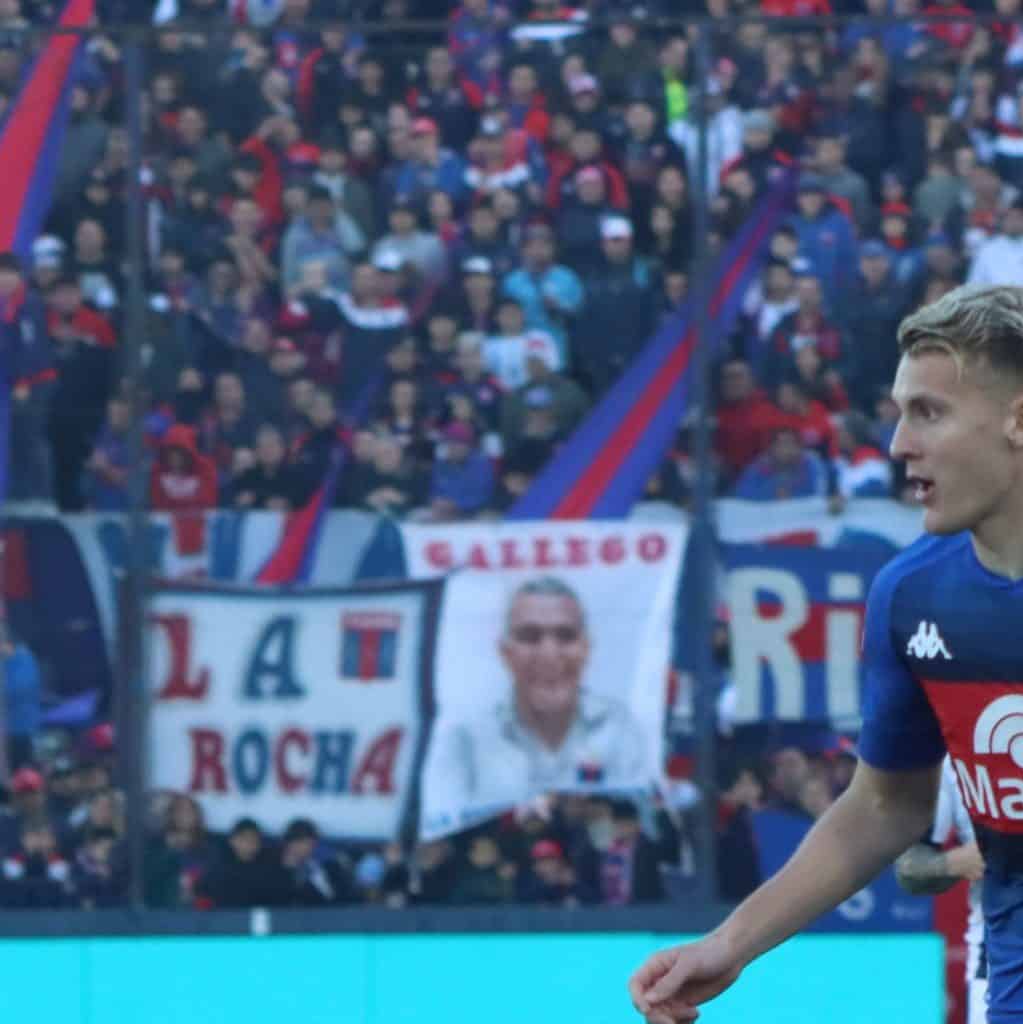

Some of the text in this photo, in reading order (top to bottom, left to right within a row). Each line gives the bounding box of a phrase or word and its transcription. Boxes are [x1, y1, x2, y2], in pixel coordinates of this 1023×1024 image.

[423, 532, 668, 571] GALLEGO
[150, 612, 307, 701] LA
[188, 727, 404, 796] ROCHA
